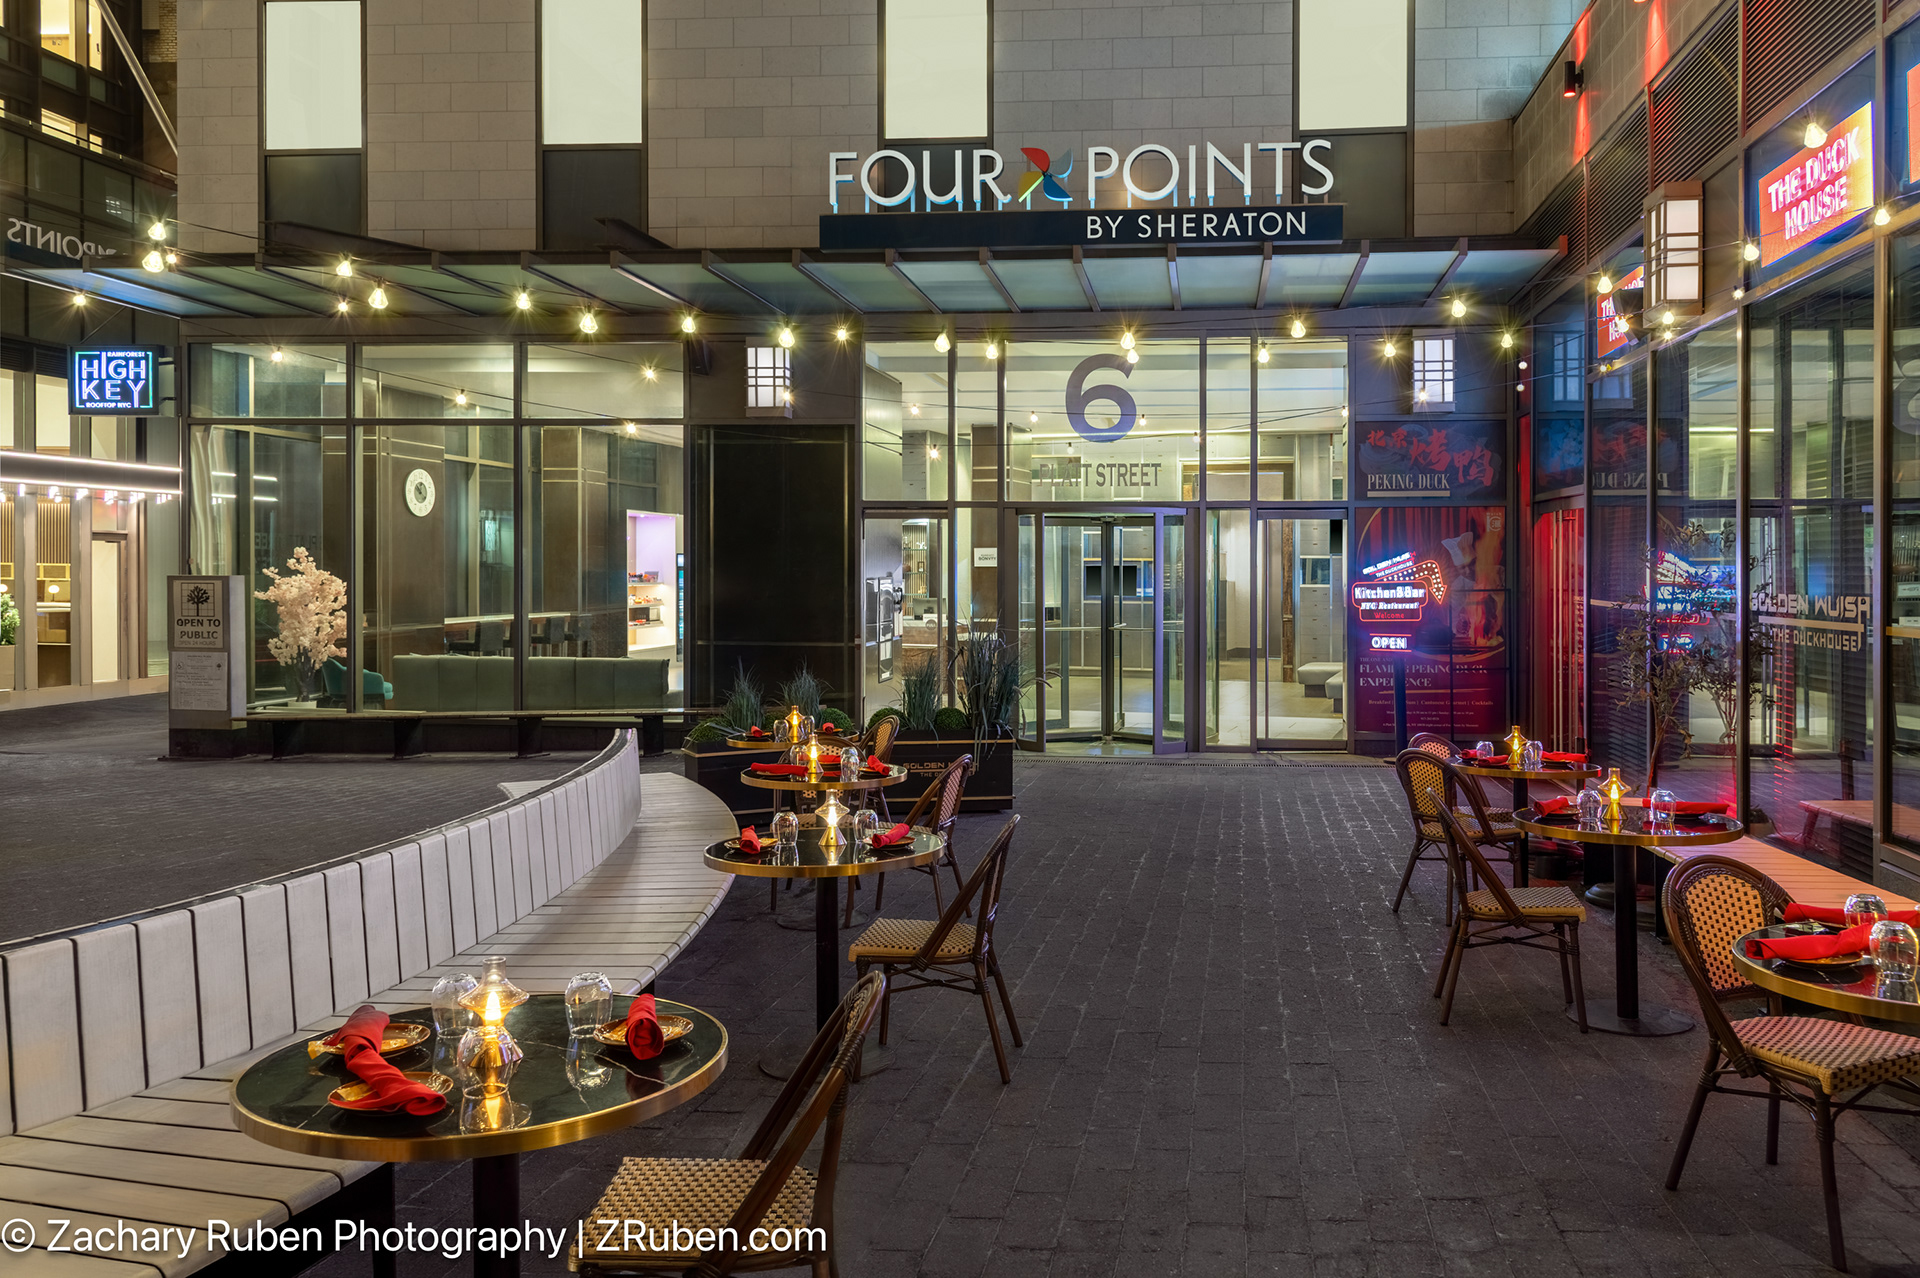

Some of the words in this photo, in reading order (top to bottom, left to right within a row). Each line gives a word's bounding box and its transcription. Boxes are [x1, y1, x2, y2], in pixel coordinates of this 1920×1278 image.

[829, 149, 1012, 206] FOUR
[1088, 139, 1334, 201] POINTS
[1768, 166, 1802, 213] THE
[1805, 126, 1860, 191] DUCK
[1785, 175, 1848, 240] HOUSE
[1087, 216, 1124, 239] BY
[1138, 211, 1306, 239] SHERATON
[81, 352, 146, 380] HIGH
[81, 380, 146, 408] KEY
[1065, 353, 1137, 443] 6
[1040, 463, 1092, 486] PLATT
[1096, 463, 1162, 486] STREET
[1367, 474, 1414, 490] PEKING
[1418, 474, 1450, 489] DUCK
[1360, 602, 1378, 610] NYC
[1378, 602, 1420, 610] Restaurant
[176, 618, 204, 627] OPEN
[207, 618, 221, 628] TO
[180, 630, 218, 640] PUBLIC
[1372, 636, 1407, 649] OPEN
[1772, 628, 1790, 644] THE
[1794, 630, 1858, 652] DUCKHOUSE
